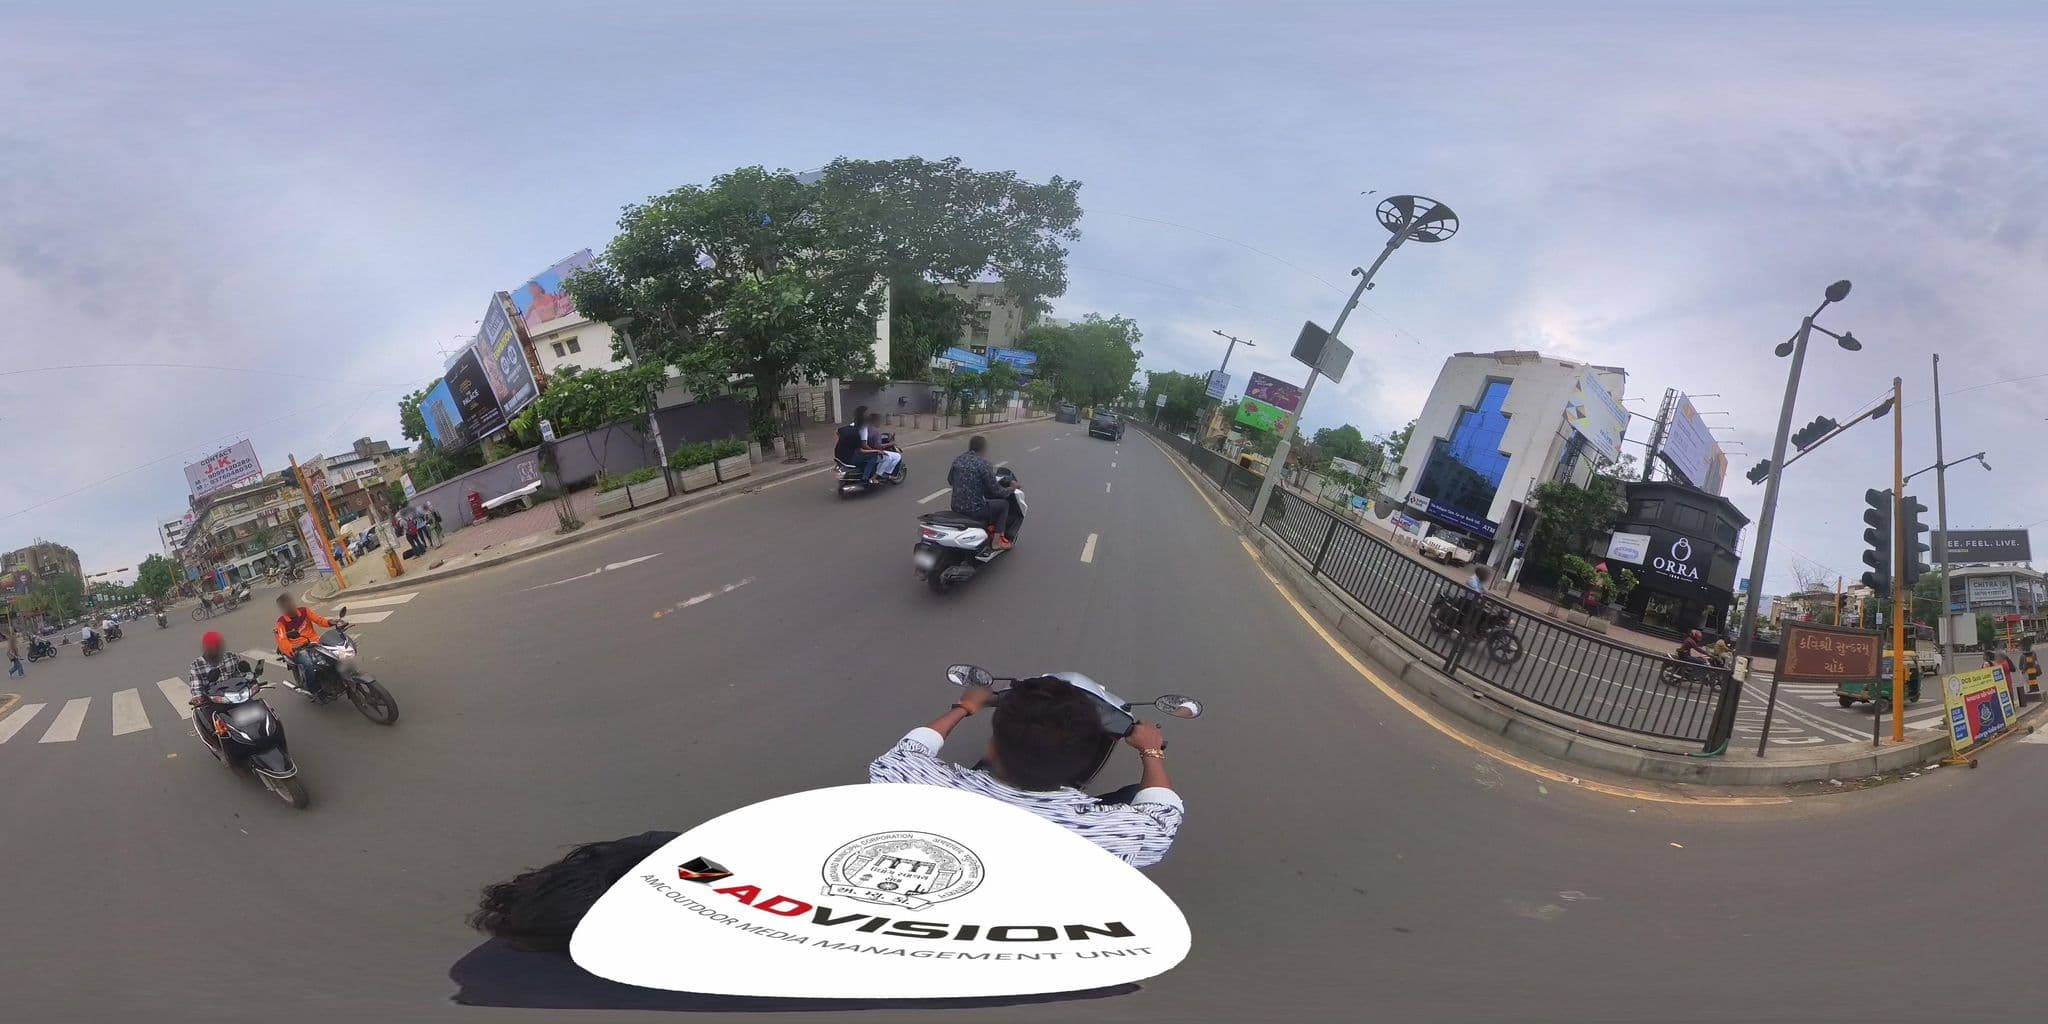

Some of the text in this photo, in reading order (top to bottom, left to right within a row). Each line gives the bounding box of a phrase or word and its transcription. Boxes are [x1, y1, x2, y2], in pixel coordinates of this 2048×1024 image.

[200, 448, 232, 466] CONTACT
[204, 456, 236, 474] J.K.
[1482, 524, 1496, 534] ATM
[1996, 539, 2020, 547] LIVE.
[1653, 557, 1699, 580] ORRA
